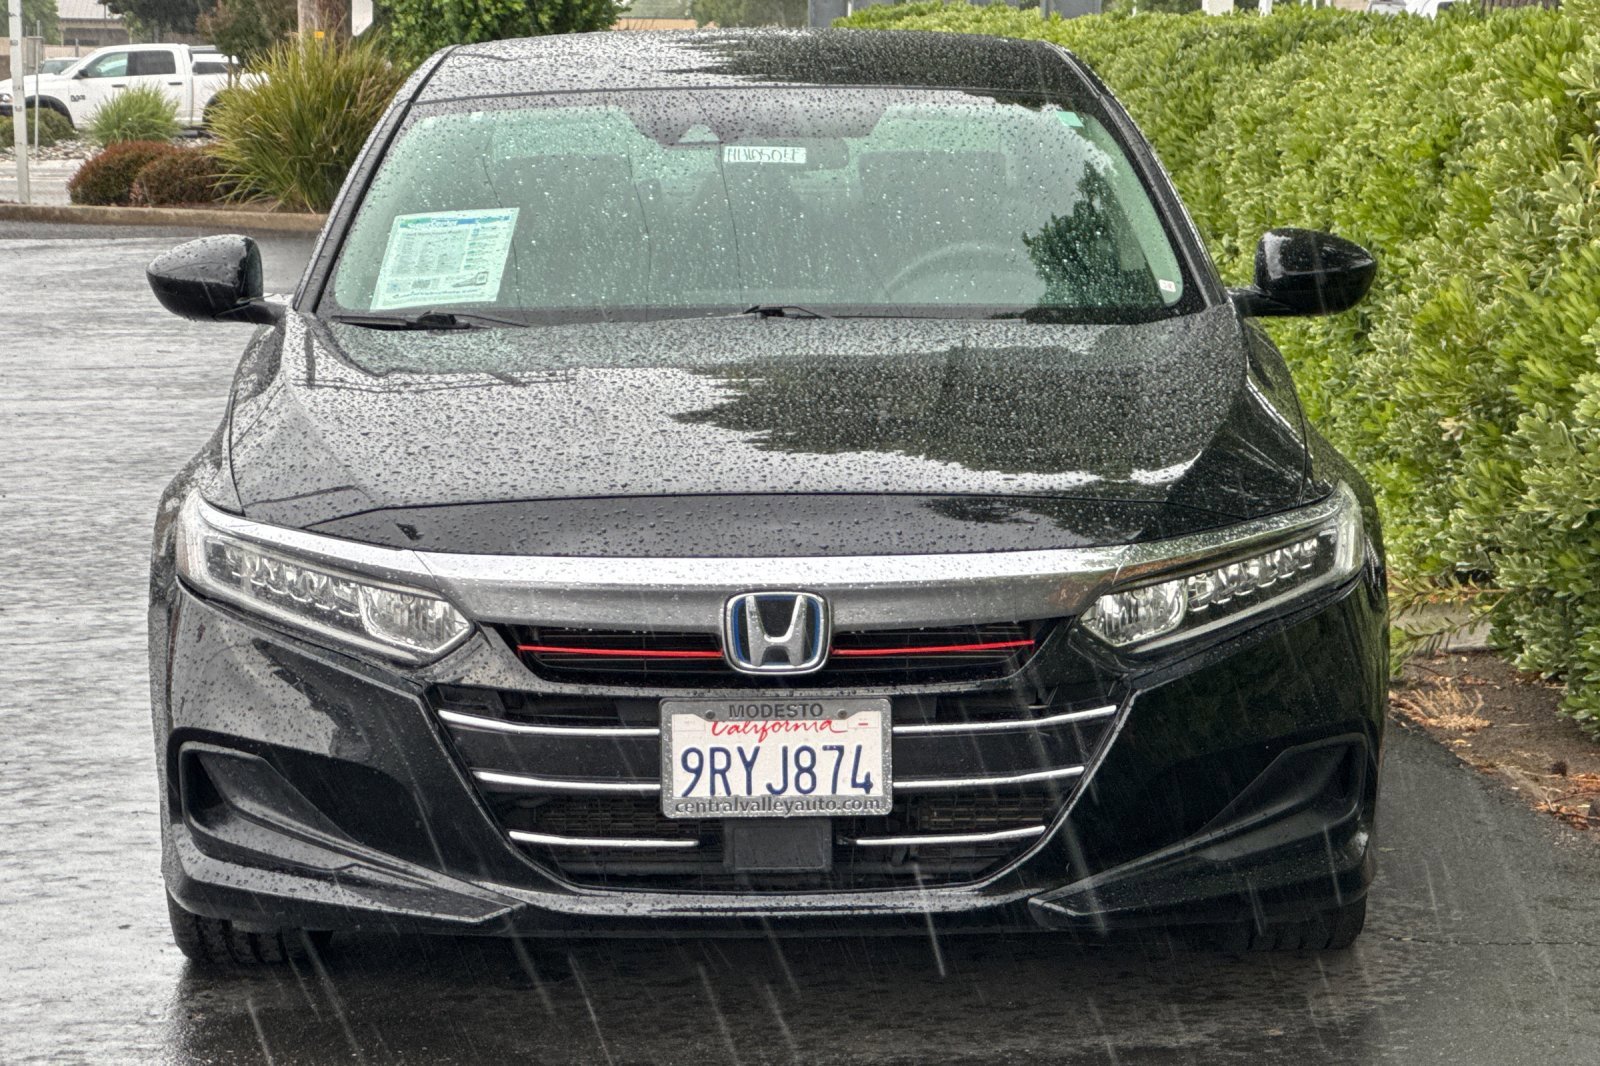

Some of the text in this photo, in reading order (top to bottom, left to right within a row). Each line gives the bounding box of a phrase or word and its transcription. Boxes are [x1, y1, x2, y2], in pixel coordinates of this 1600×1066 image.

[728, 703, 824, 719] MODESTO
[711, 719, 848, 743] California
[680, 744, 874, 798] 9RYJ874
[675, 795, 881, 816] centralvalleyauto.com
